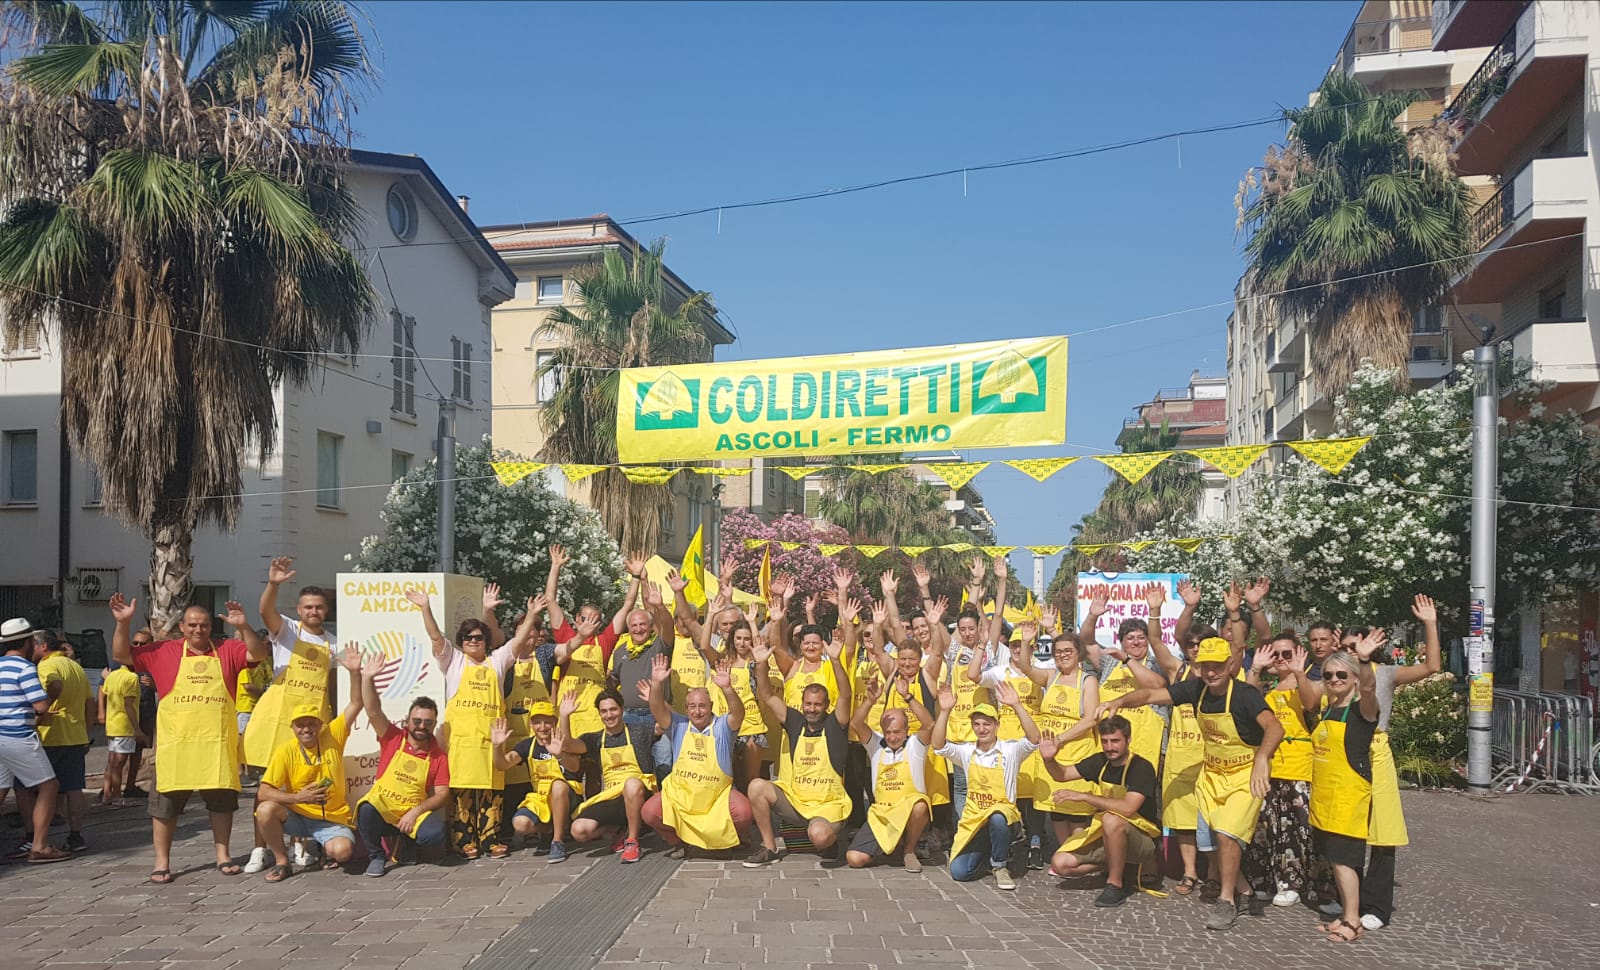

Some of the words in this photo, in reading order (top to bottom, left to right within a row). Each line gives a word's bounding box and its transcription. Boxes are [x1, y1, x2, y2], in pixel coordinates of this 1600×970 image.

[708, 362, 960, 424] COLDIRETTI
[715, 430, 818, 451] ASCOLI
[848, 424, 951, 446] FERMO
[344, 581, 438, 596] CAMPAGNA
[360, 598, 422, 612] AMICA
[1130, 604, 1149, 617] BEA
